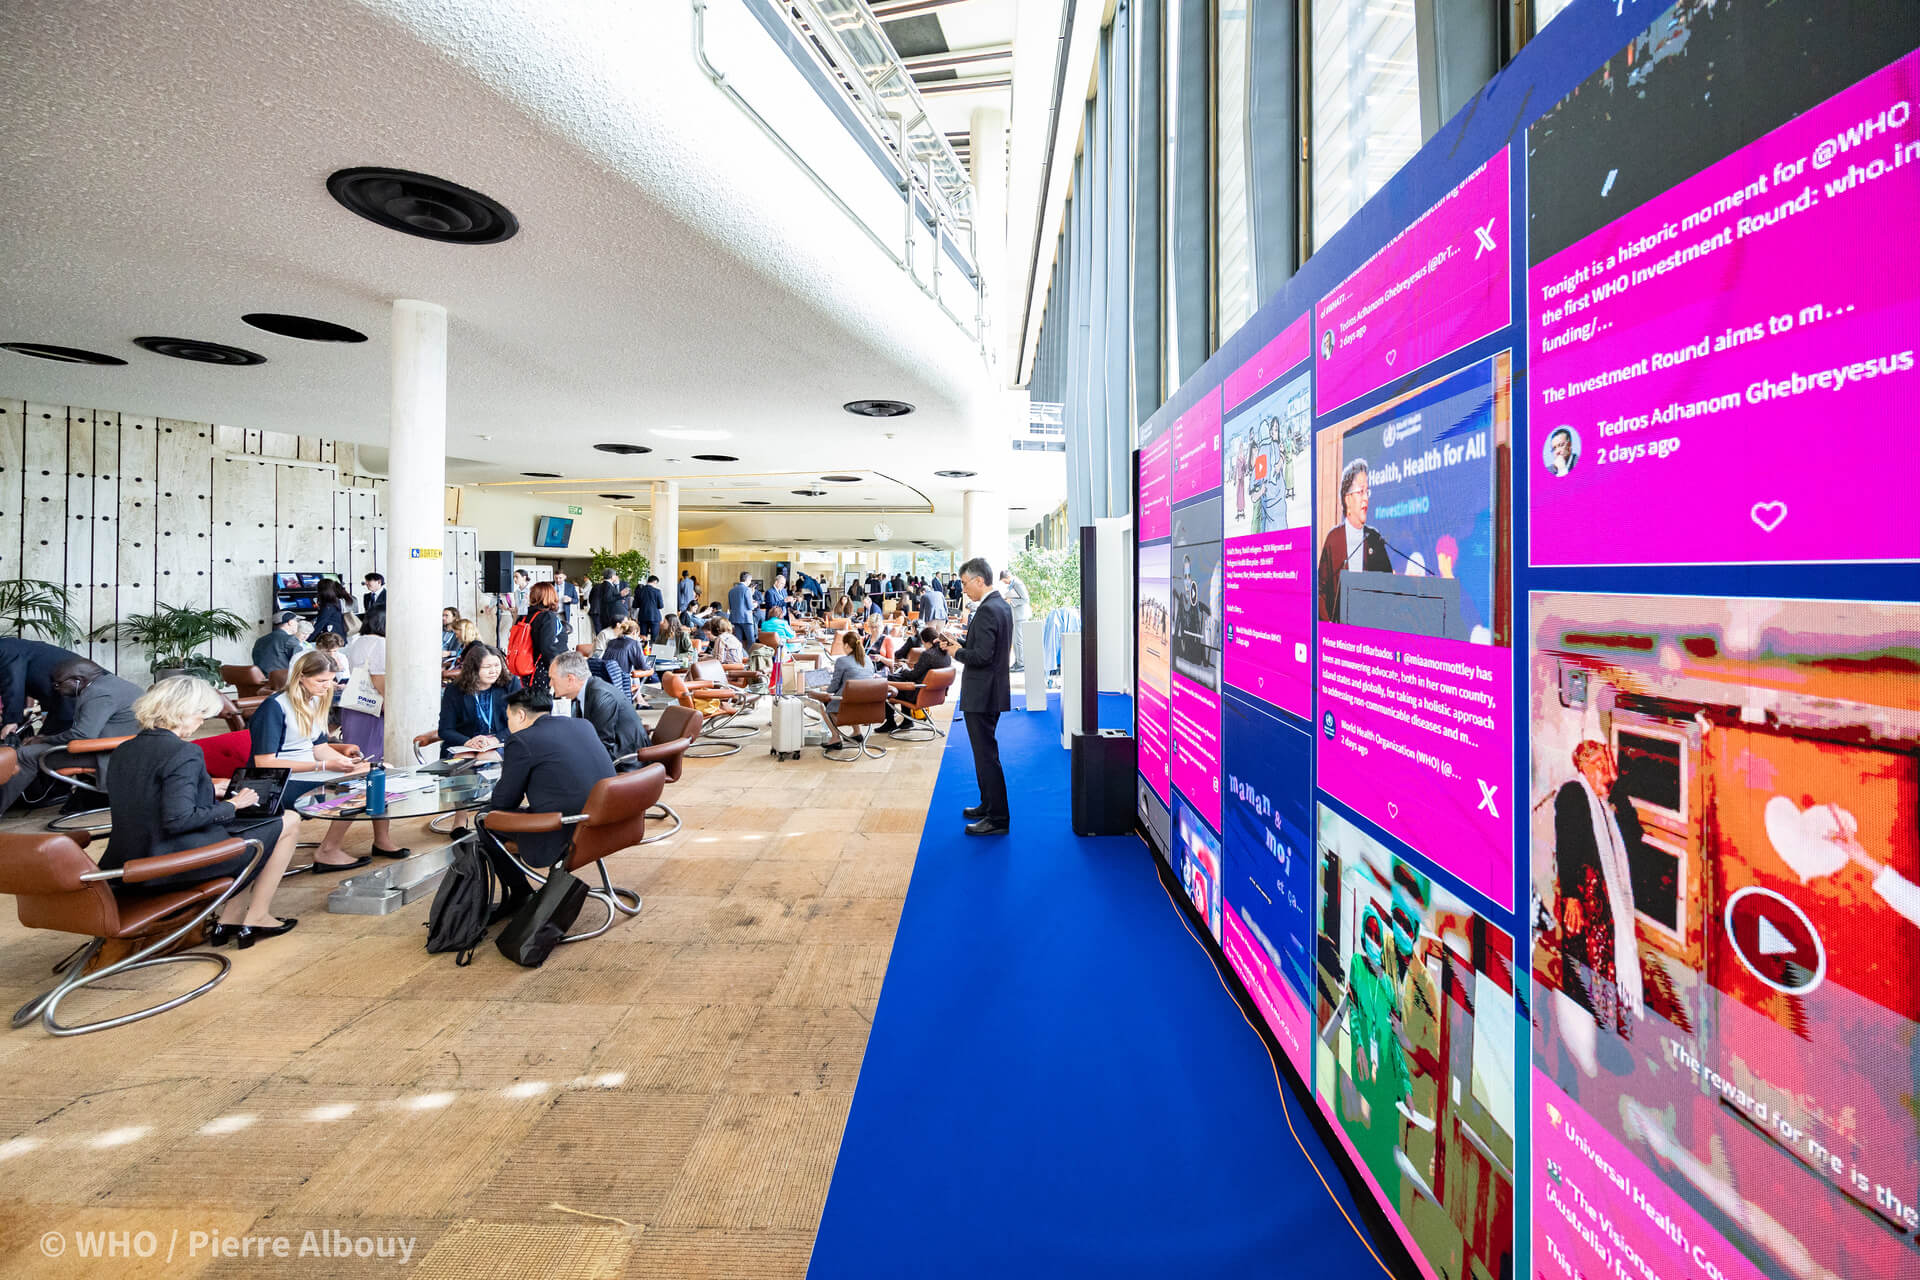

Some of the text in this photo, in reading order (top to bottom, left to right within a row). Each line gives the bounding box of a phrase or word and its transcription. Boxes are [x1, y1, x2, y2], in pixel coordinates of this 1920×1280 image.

[1542, 101, 1909, 300] Tonight is a historic moment for @WHO
[1542, 308, 1562, 326] the
[1564, 293, 1590, 316] first
[1592, 275, 1628, 303] WHO
[1632, 227, 1732, 286] Investment
[1737, 187, 1818, 238] Round:
[1385, 265, 1427, 302] Ghebreyesus
[1543, 387, 1566, 404] The
[1568, 359, 1648, 397] Investment
[1652, 336, 1709, 371] Round
[1714, 323, 1764, 351] aims
[1769, 315, 1793, 334] to
[1597, 351, 1914, 437] Tedros Adhanom Ghebreyesus
[1368, 432, 1486, 487] Health, Health for All
[1597, 437, 1680, 464] 2 days ago
[1322, 636, 1336, 648] Prime
[1356, 643, 1362, 654] of
[1476, 665, 1493, 682] has
[1351, 679, 1361, 689] and
[1362, 680, 1385, 698] globally,
[1387, 686, 1395, 699] for
[1396, 691, 1417, 709] taking
[1418, 698, 1422, 708] a
[1424, 697, 1451, 717] holistic
[1453, 708, 1494, 730] approach
[1371, 666, 1400, 683] advocate,
[1400, 671, 1416, 685] both
[1418, 675, 1425, 688] in
[1426, 677, 1439, 691] her
[1440, 683, 1457, 696] own
[1459, 688, 1496, 709] country,
[1354, 699, 1410, 723] non-communicable
[1411, 714, 1442, 735] diseases
[1442, 727, 1458, 740] and
[1356, 725, 1375, 742] Health
[1375, 734, 1416, 759] Organization
[1416, 749, 1440, 773] (WHO)
[1228, 773, 1271, 817] maman
[1265, 826, 1292, 878] moi
[1671, 1039, 1701, 1075] The
[1703, 1065, 1768, 1122] reward
[1772, 1110, 1803, 1143] for
[1808, 1138, 1844, 1175] me
[1850, 1164, 1870, 1193] is
[1565, 1121, 1630, 1196] Universal
[1633, 1187, 1689, 1254] Health
[1546, 1183, 1612, 1269] (Australia)
[1546, 1235, 1572, 1278] This
